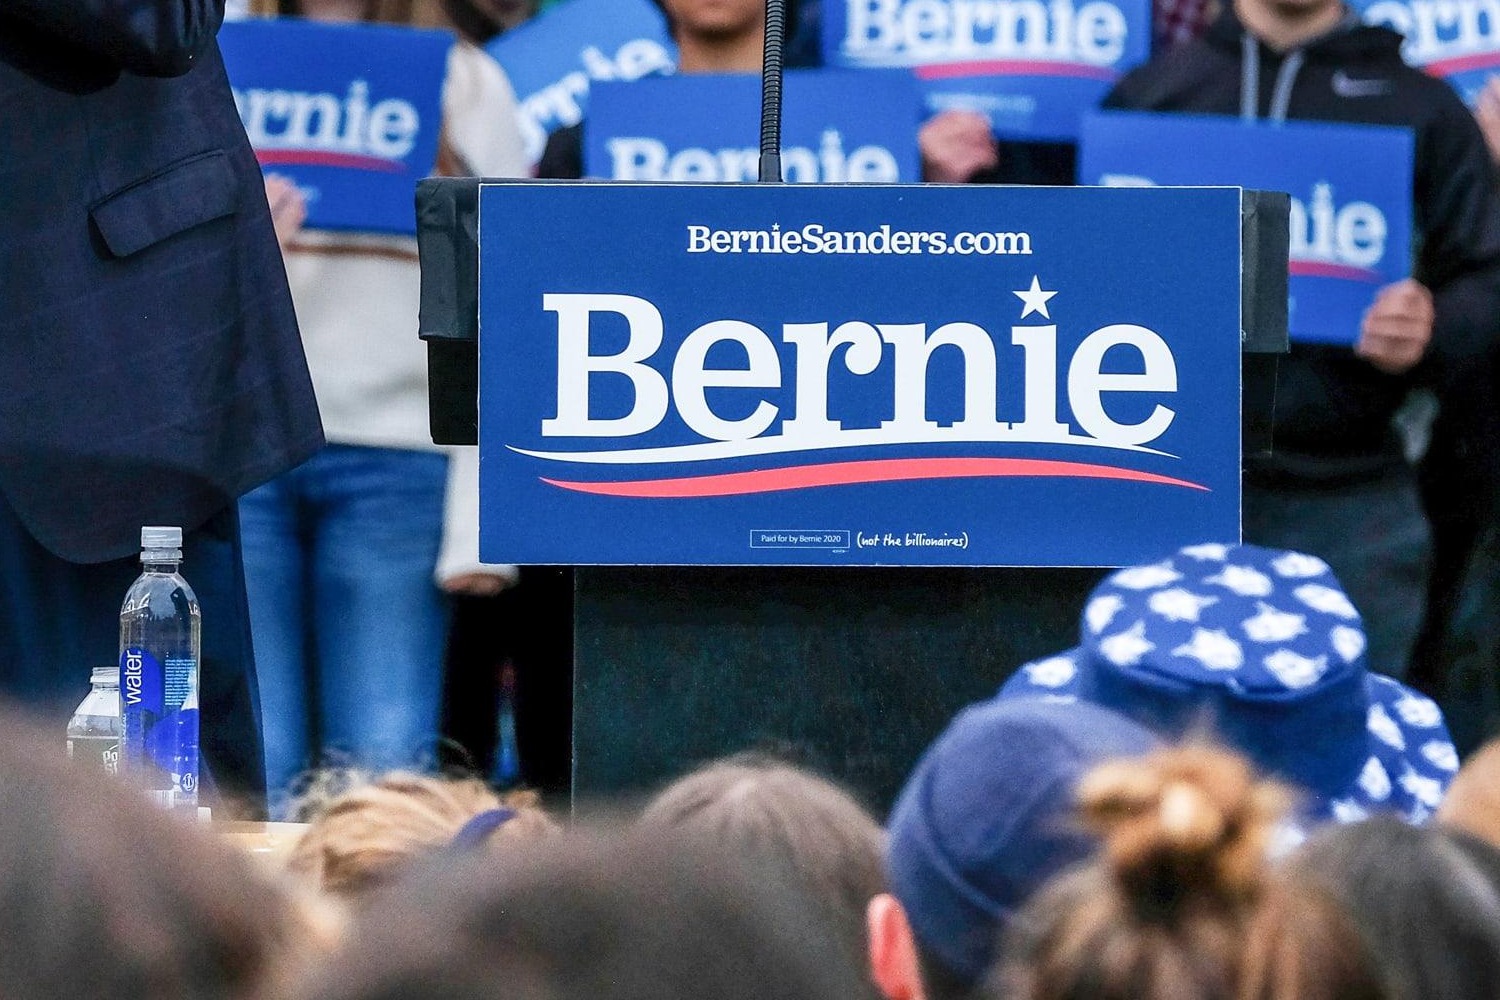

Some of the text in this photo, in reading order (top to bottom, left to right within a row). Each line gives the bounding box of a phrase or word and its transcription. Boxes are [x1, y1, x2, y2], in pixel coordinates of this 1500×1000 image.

[234, 78, 421, 160] rnie
[686, 222, 1033, 255] BernieSanders.com
[541, 275, 1179, 446] Bernie
[760, 534, 842, 545] Paid for by Bernie 2020
[856, 531, 969, 549] (not the billionaires)
